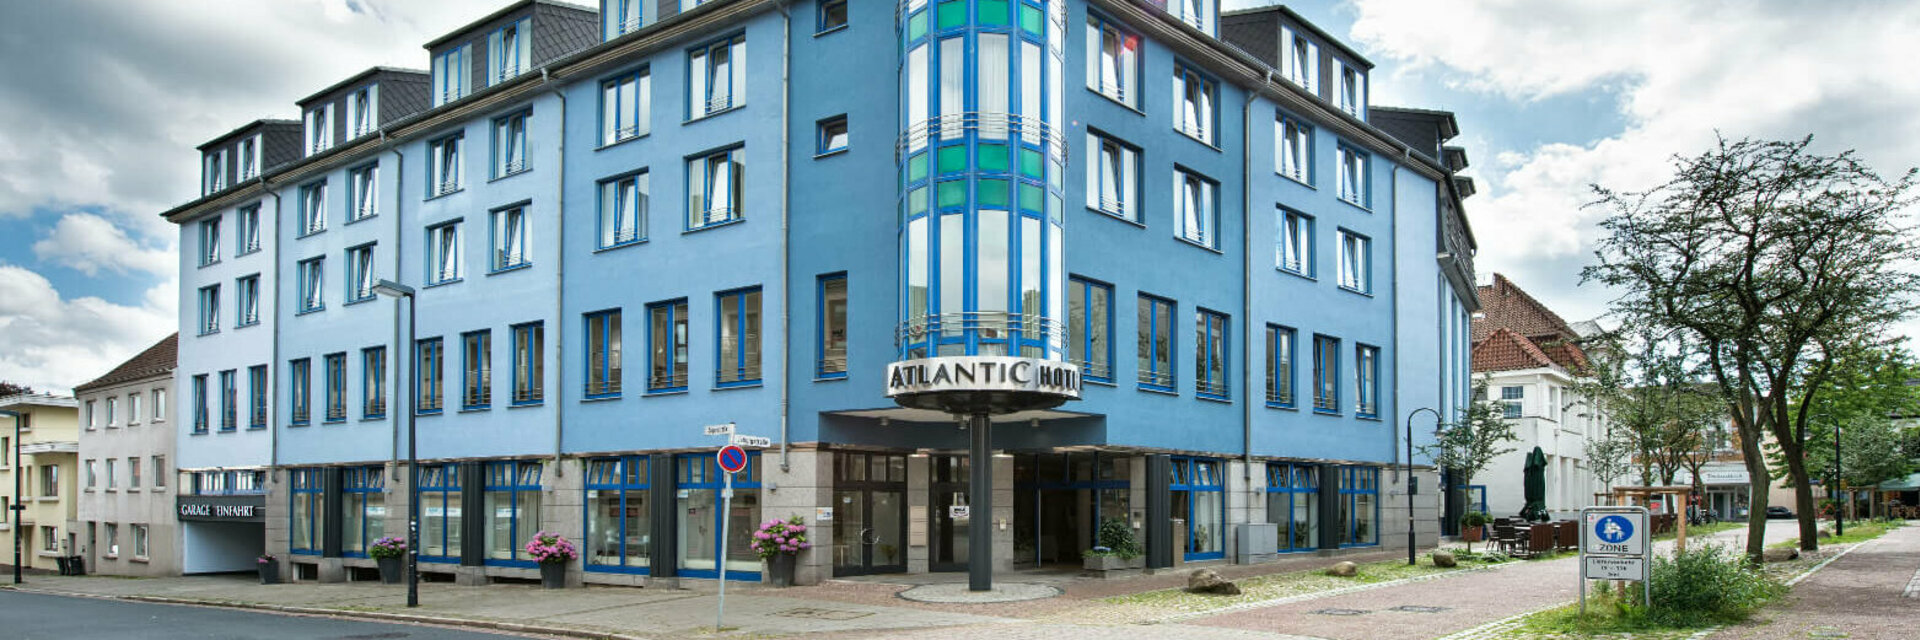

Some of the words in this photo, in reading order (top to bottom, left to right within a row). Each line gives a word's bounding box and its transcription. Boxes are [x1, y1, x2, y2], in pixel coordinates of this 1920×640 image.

[890, 361, 1030, 388] ATLANTIC
[181, 504, 210, 516] GARAGE
[216, 505, 254, 517] EINFAHRT
[1599, 543, 1629, 553] ZONE
